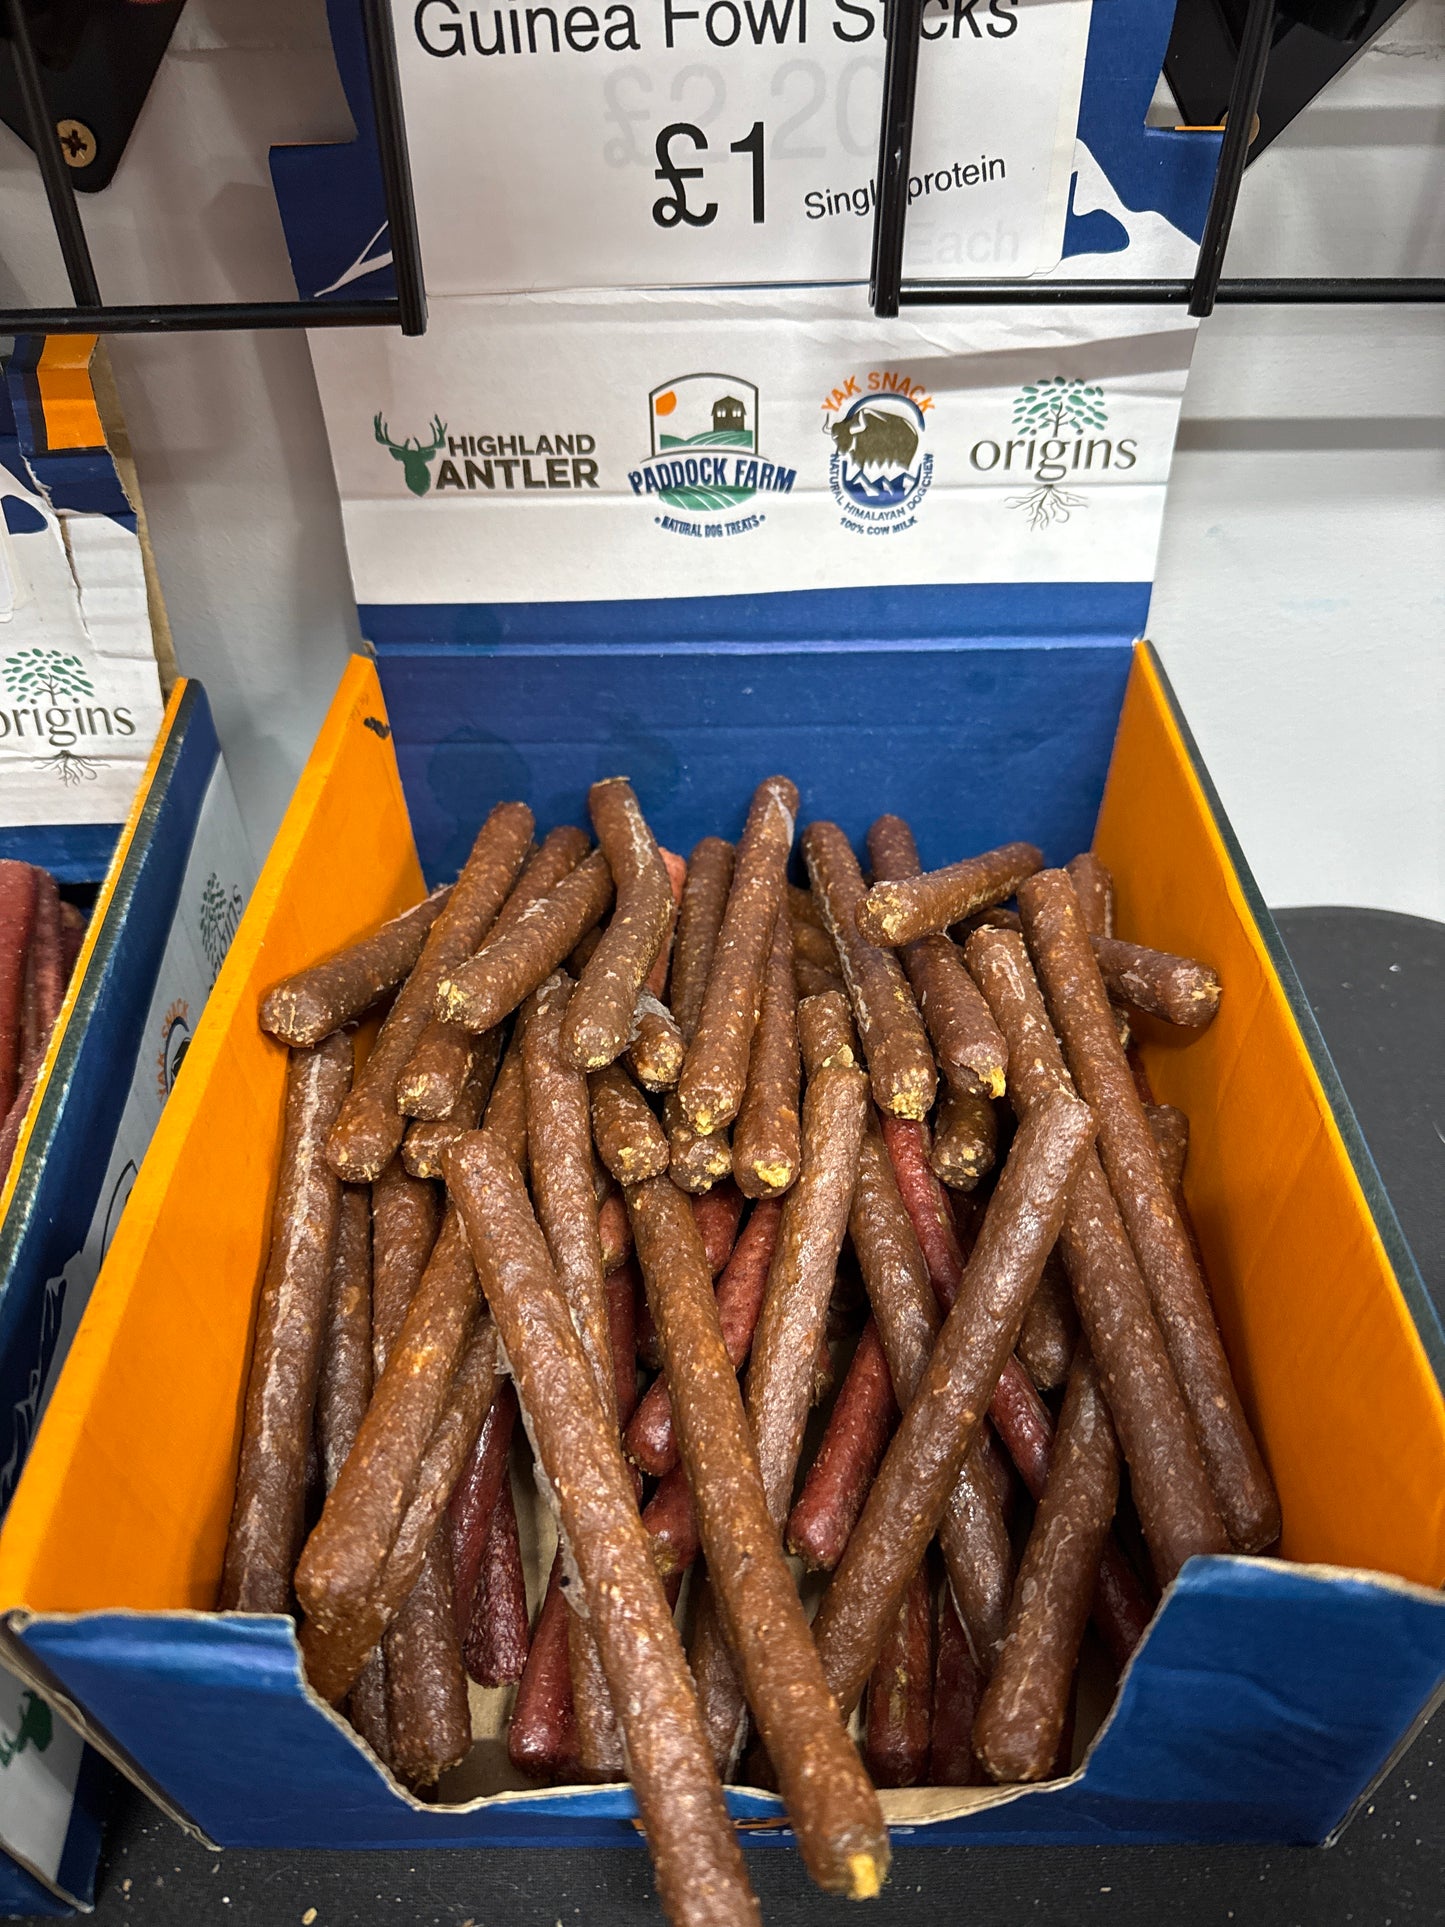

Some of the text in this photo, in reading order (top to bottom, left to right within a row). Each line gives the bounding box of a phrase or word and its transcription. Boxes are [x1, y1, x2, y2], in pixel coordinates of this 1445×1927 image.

[414, 0, 1018, 58] Guinea Fowl Scks
[652, 121, 765, 228] £1
[804, 155, 1006, 220] Singl protein
[821, 371, 935, 413] YAK SNACK
[448, 434, 596, 457] HIGHLAND
[969, 429, 1138, 482] origins
[435, 458, 600, 489] ANTLER
[627, 457, 798, 497] PADDOCK FARM
[829, 453, 844, 506] NATURAL
[843, 501, 906, 521] HIMALAYAN
[661, 514, 760, 538] NATURAL DOG TREATS
[840, 515, 918, 536] 100% COW MILK
